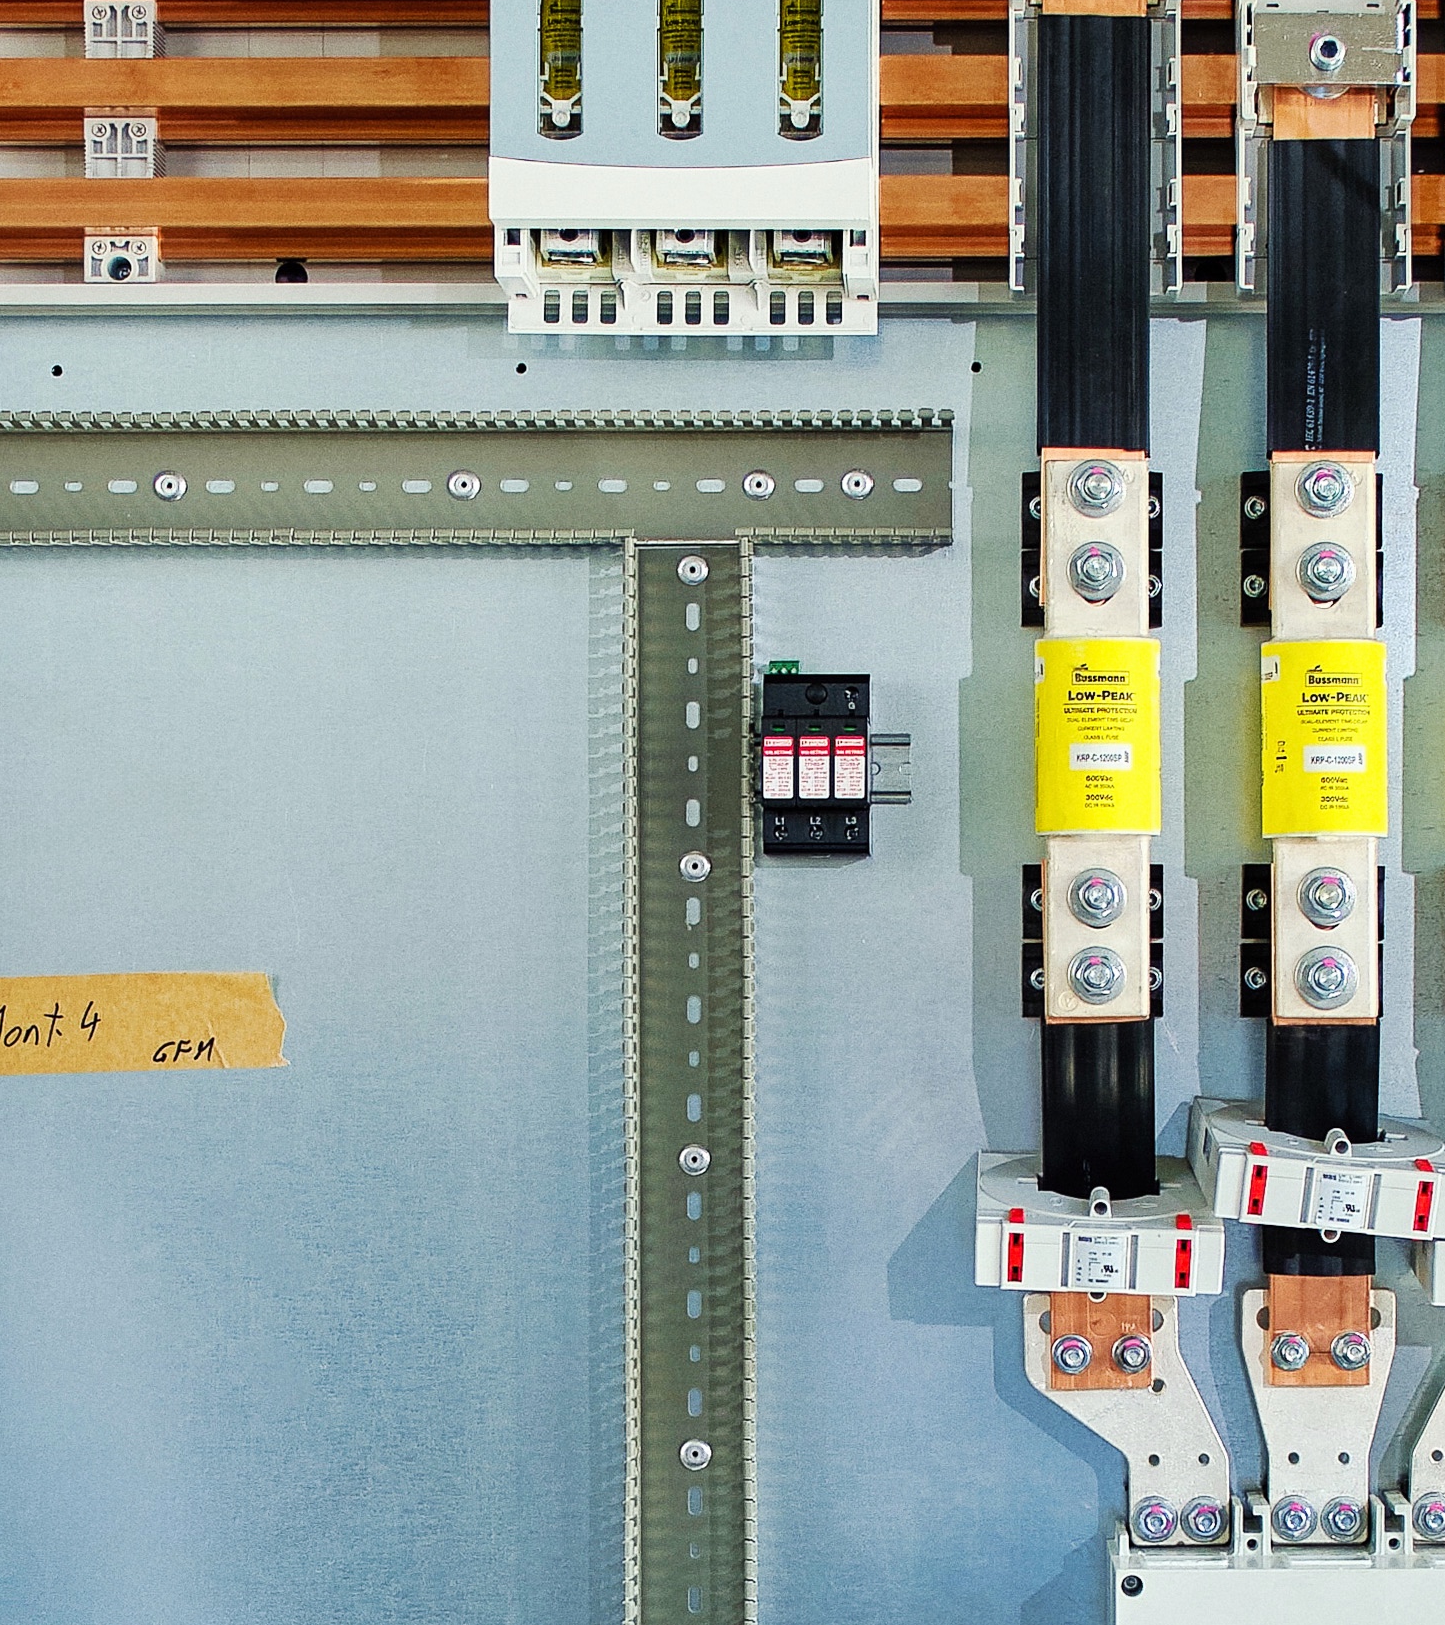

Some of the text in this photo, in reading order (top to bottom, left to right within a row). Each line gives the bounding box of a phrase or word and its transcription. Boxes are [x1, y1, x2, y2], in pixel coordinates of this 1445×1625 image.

[1075, 673, 1126, 683] Bussmann
[1309, 675, 1359, 685] Bussmann
[79, 1000, 102, 1042] 4
